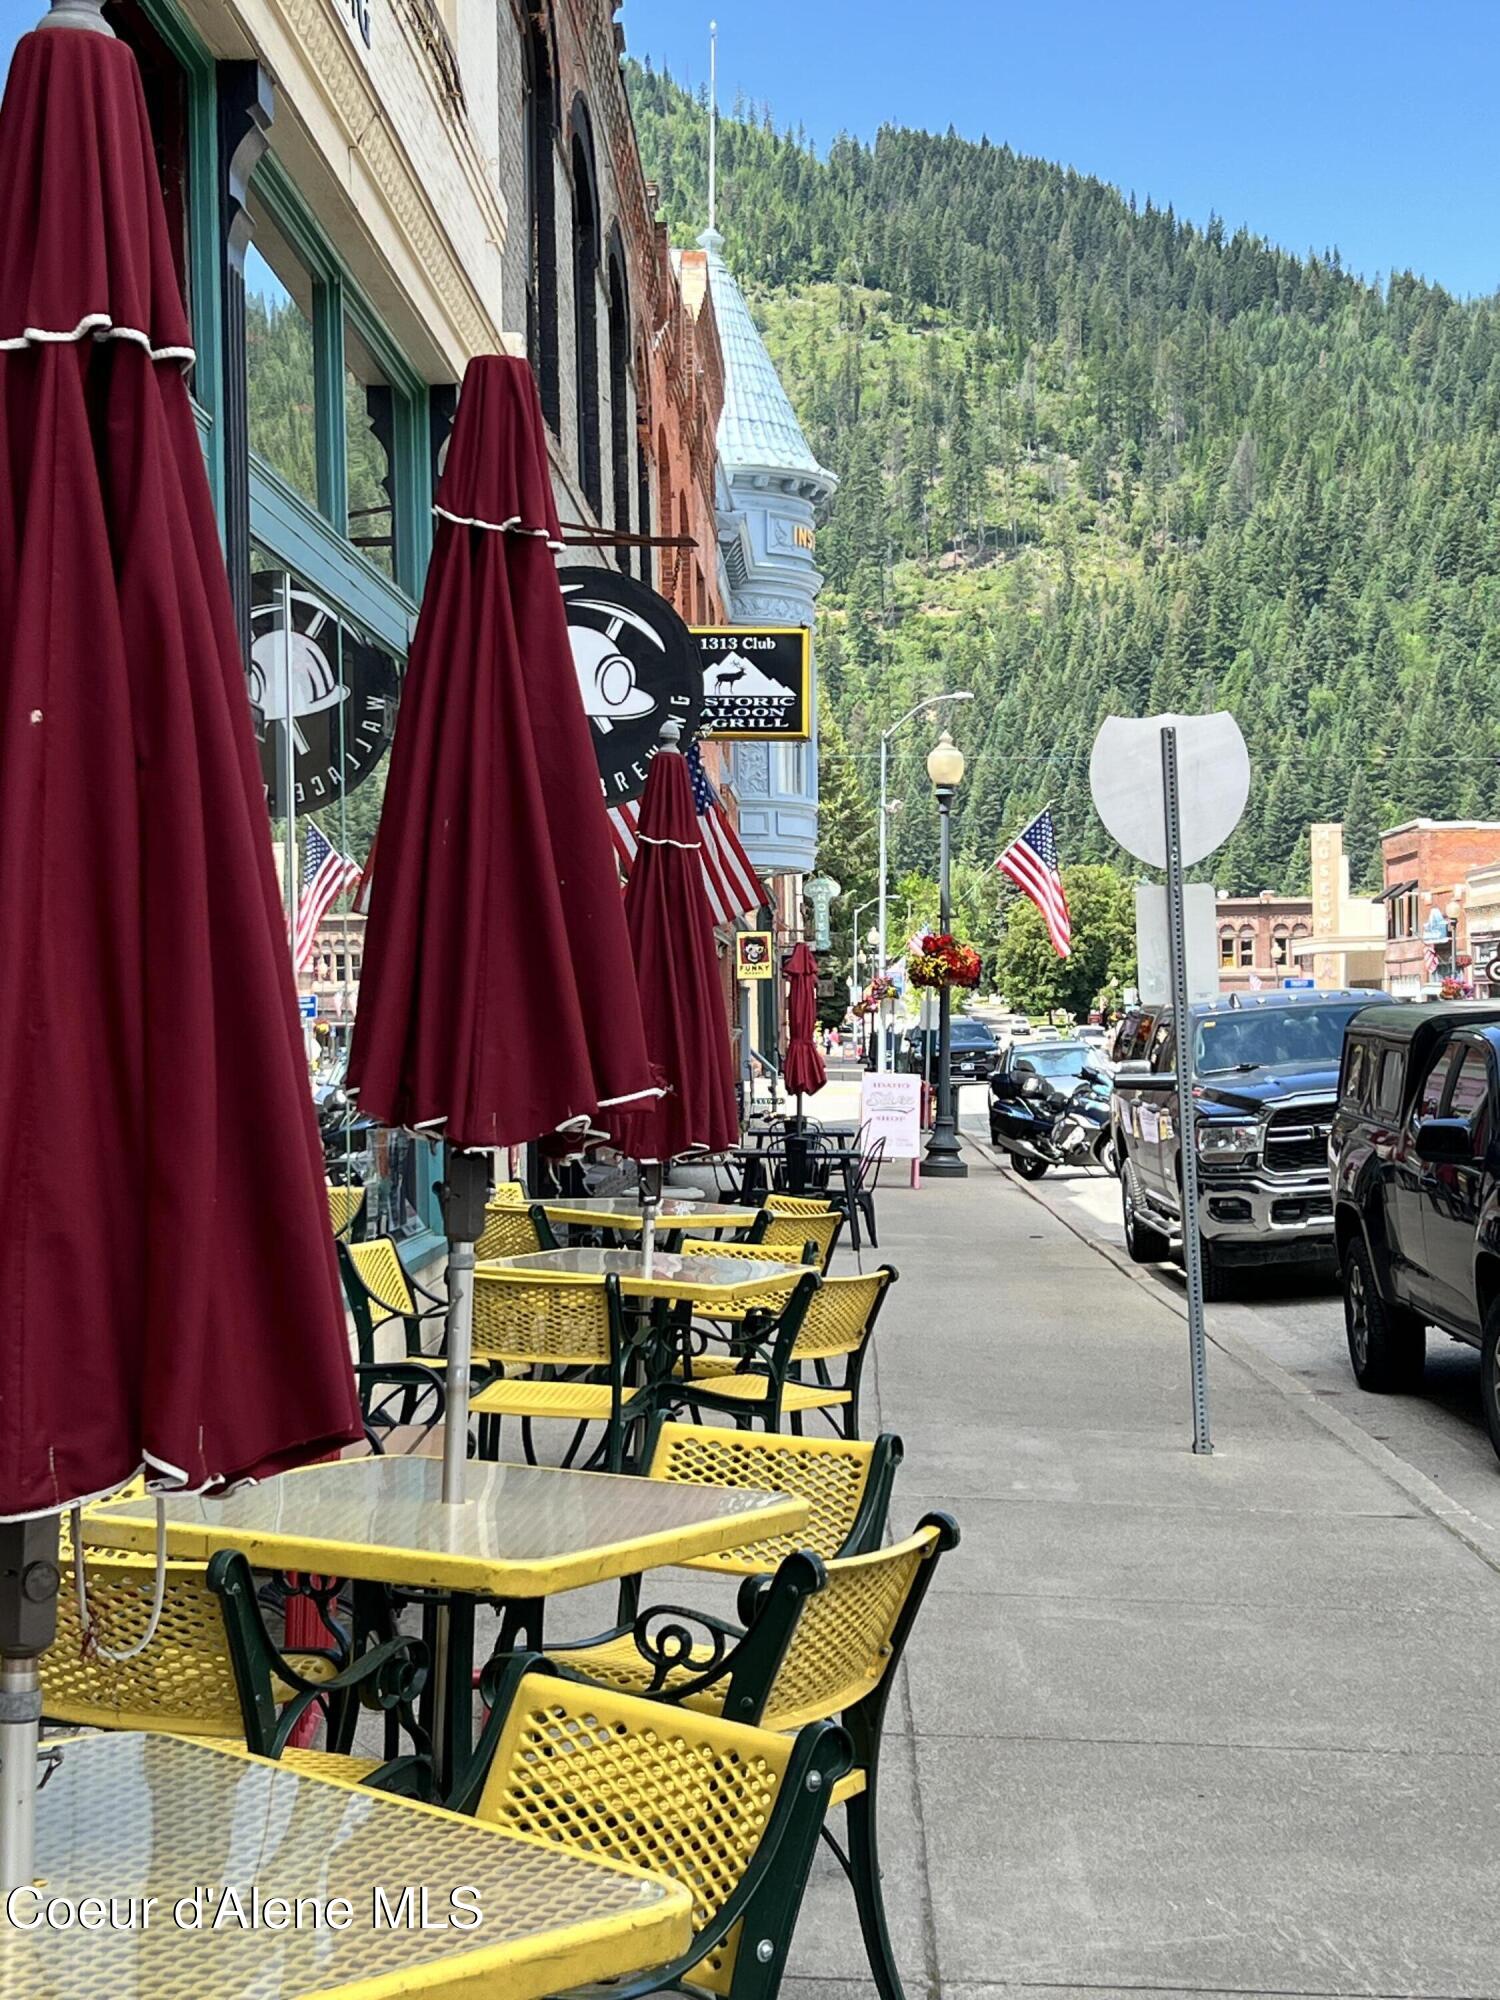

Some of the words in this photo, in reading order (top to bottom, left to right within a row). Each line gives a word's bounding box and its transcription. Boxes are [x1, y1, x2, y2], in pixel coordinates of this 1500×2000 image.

[700, 637, 738, 649] 1313
[742, 637, 776, 649] Club
[704, 697, 795, 706] STORIC
[699, 707, 785, 717] ALOON
[711, 718, 789, 728] GRILL
